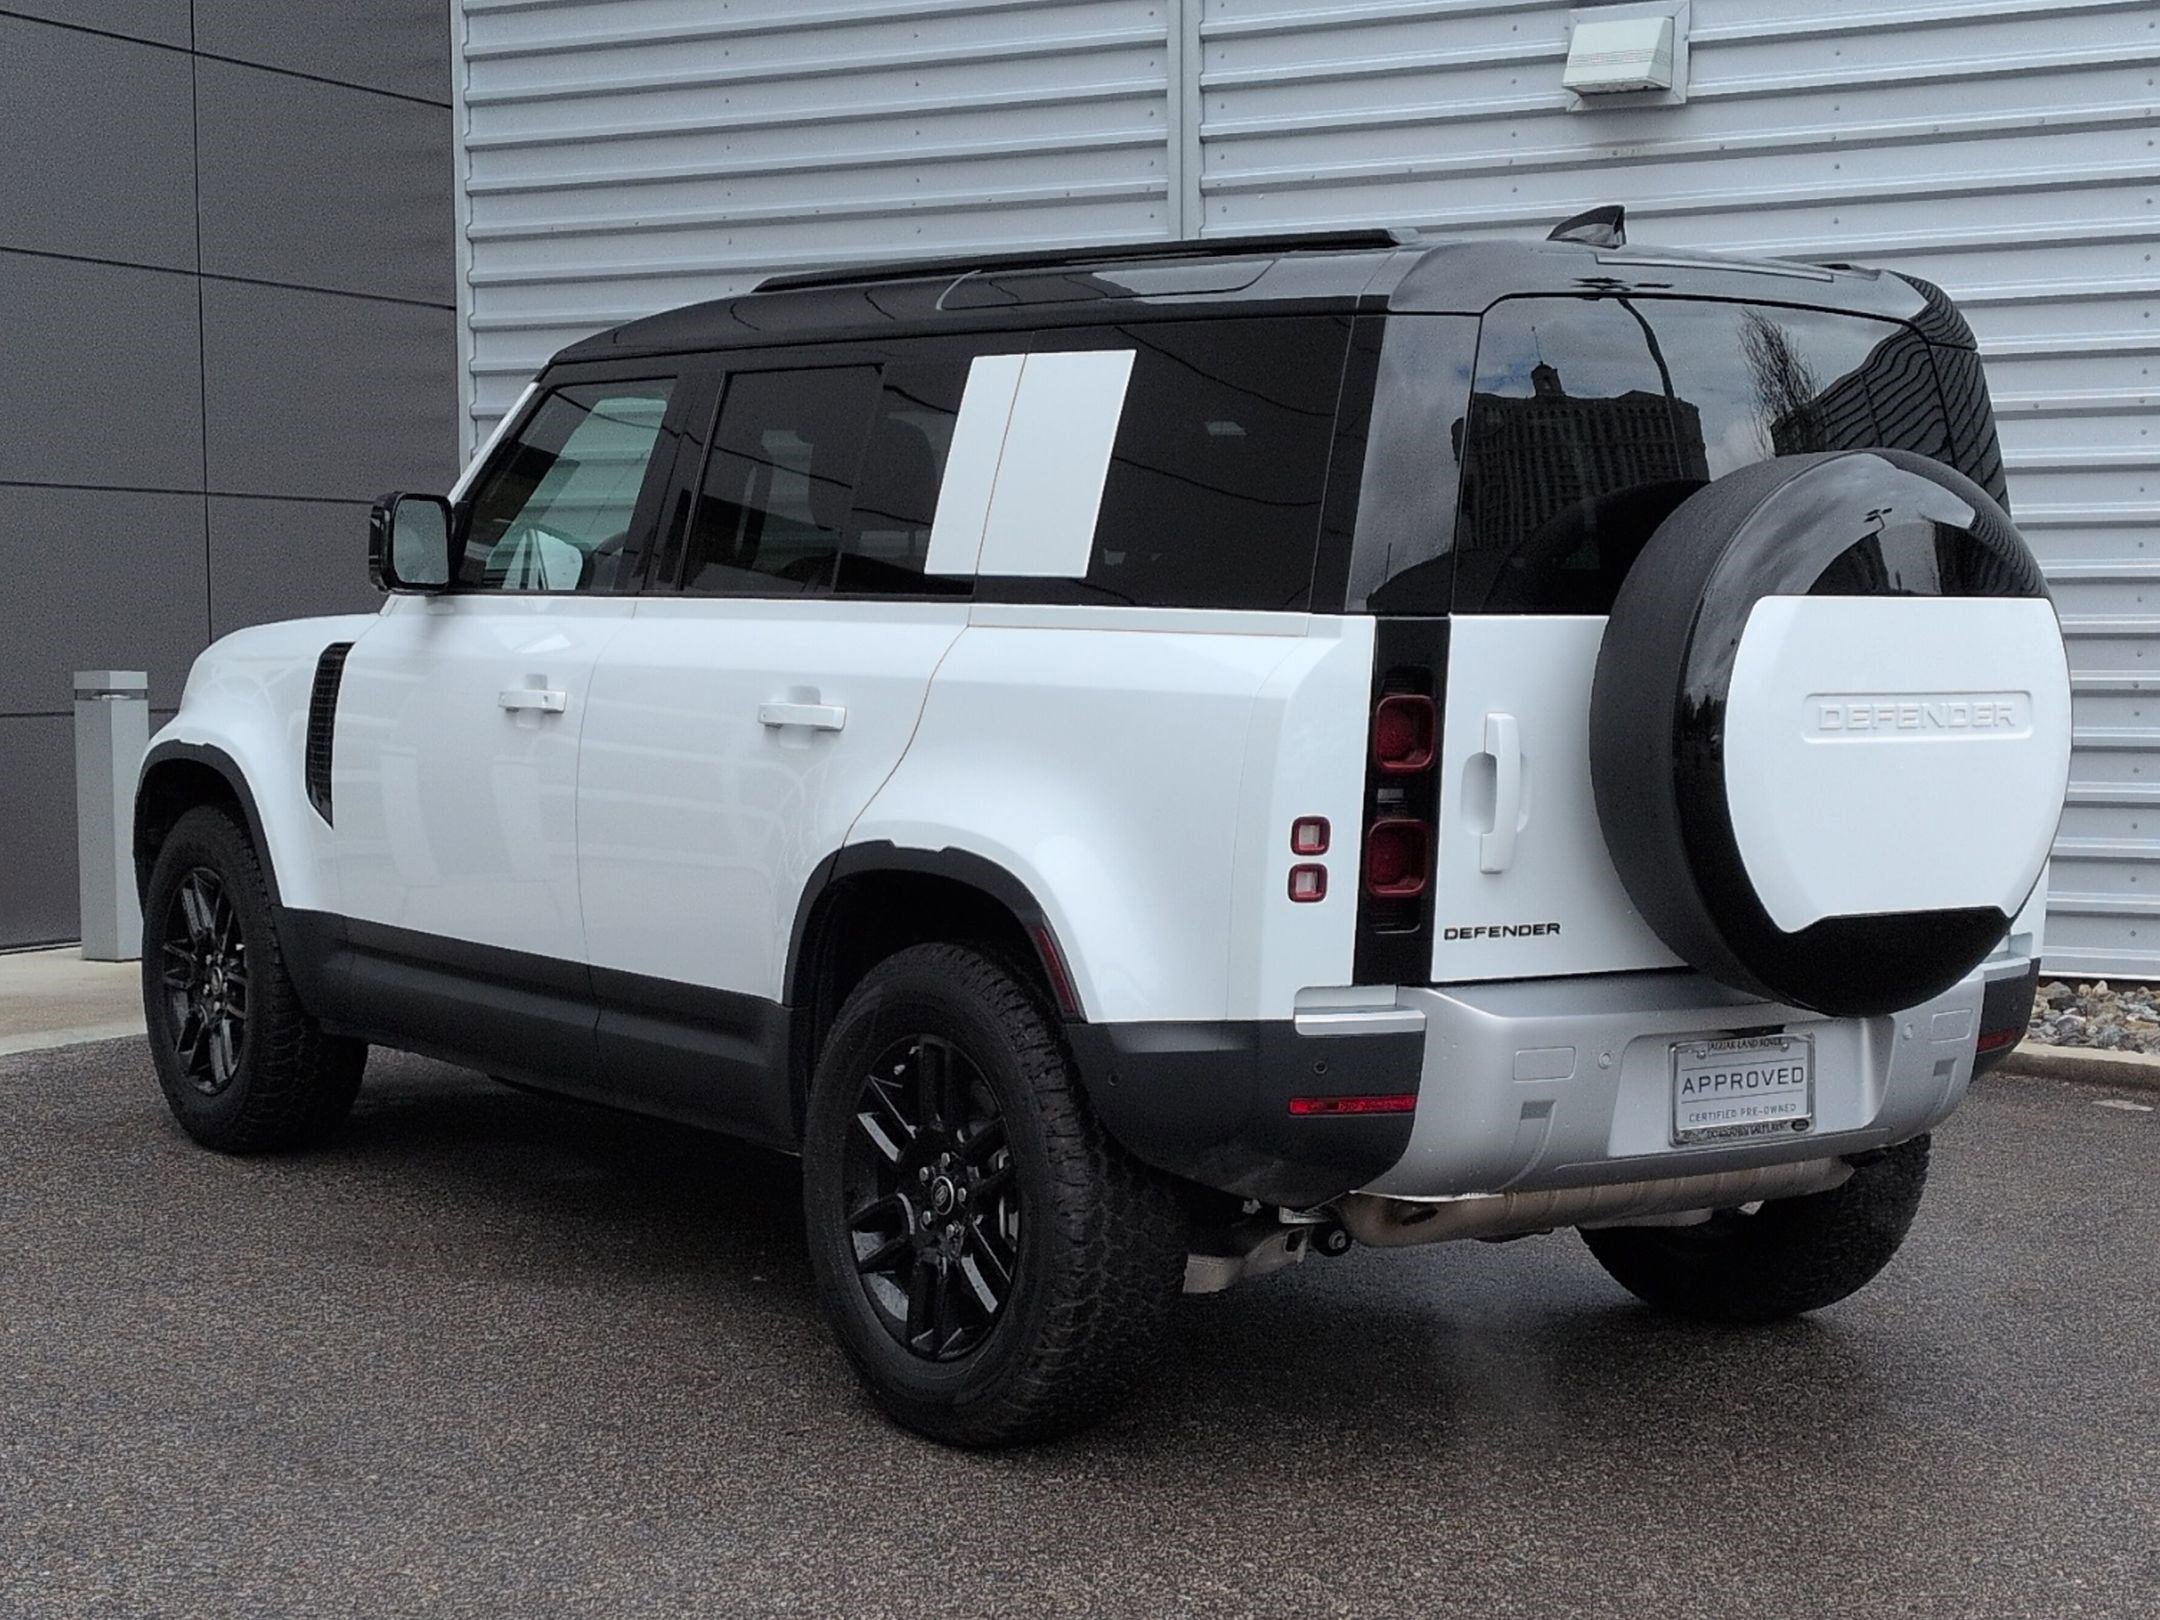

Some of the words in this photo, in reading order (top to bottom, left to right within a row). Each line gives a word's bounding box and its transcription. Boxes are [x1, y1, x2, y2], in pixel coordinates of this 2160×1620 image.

[1818, 701, 2016, 730] DEFENDER
[1443, 922, 1561, 941] DEFENDER
[1681, 1066, 1804, 1095] APPROVED
[1688, 1108, 1737, 1123] CERTIFIED
[1740, 1103, 1797, 1117] PRE-OWNED
